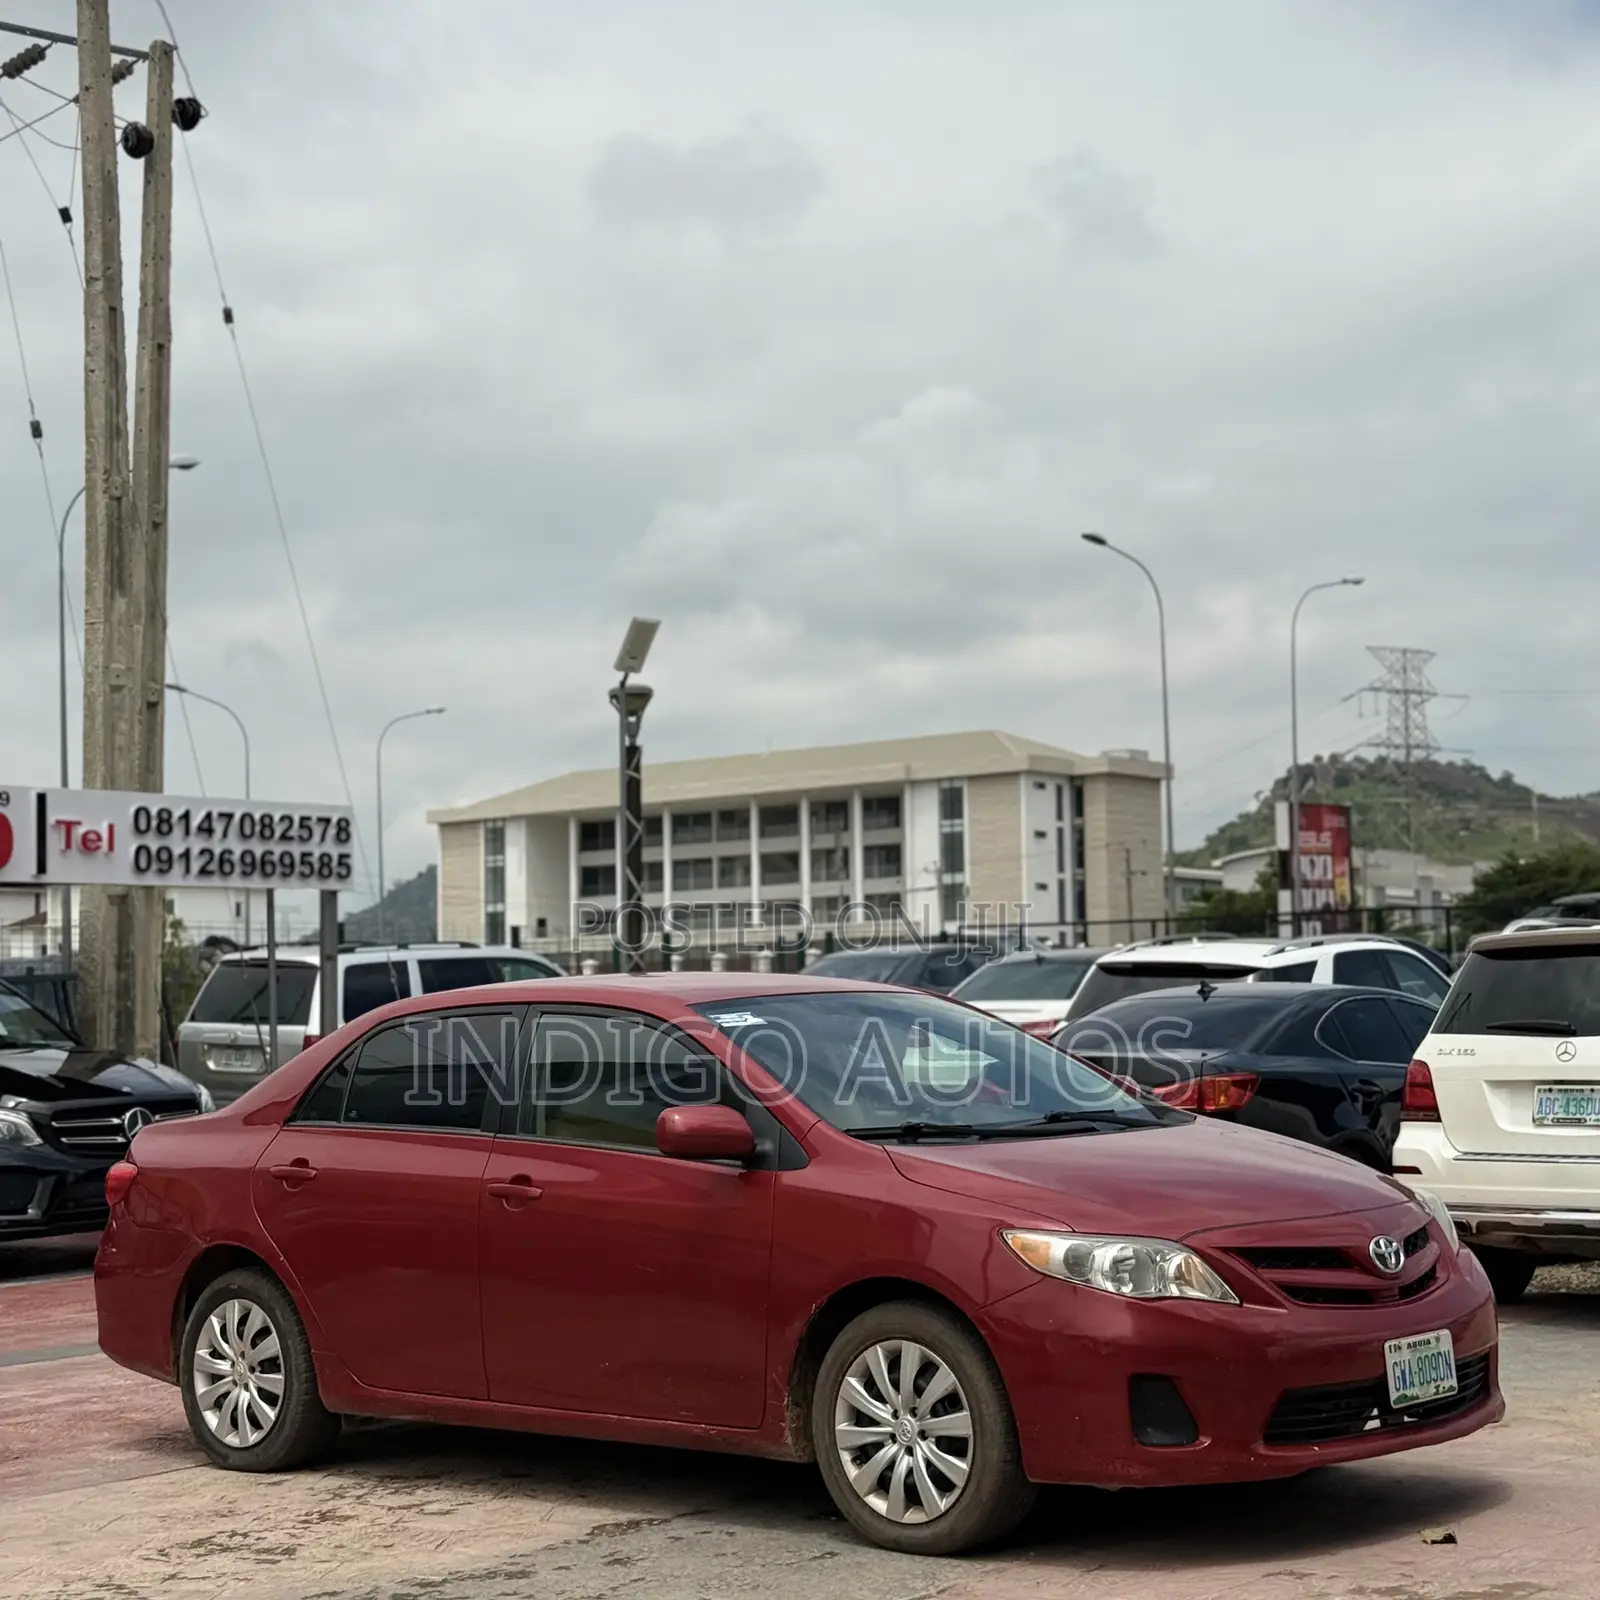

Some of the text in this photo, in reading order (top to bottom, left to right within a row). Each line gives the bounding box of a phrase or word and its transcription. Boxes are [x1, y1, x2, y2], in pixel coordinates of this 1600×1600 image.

[55, 819, 116, 854] Tel
[133, 806, 351, 844] 08147082578
[133, 844, 352, 880] 09126969585
